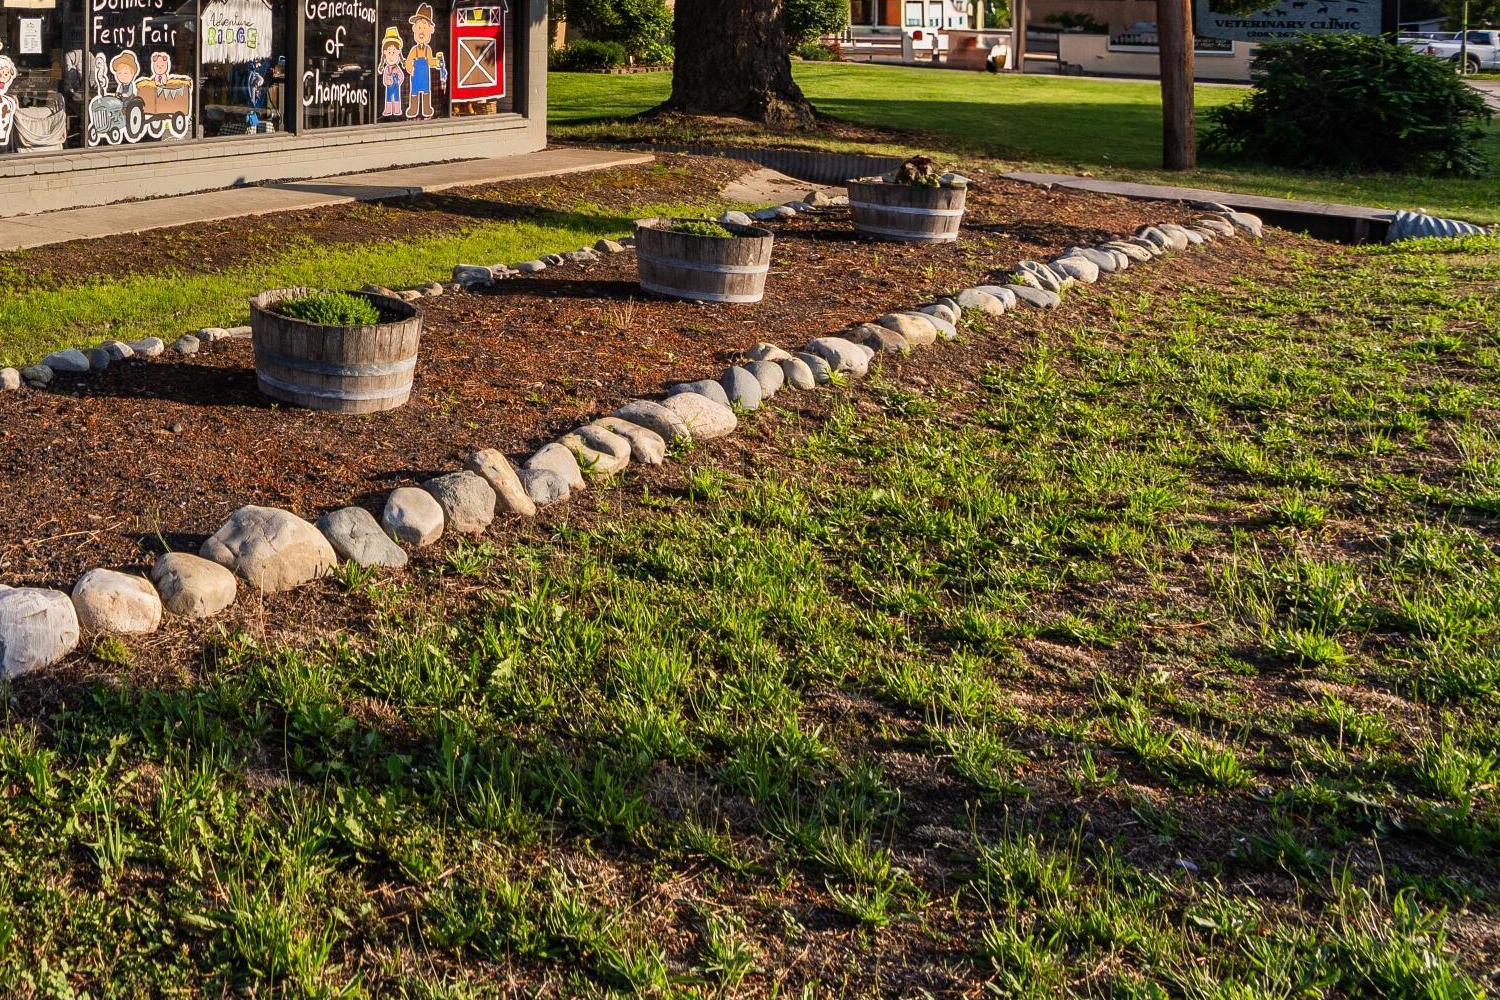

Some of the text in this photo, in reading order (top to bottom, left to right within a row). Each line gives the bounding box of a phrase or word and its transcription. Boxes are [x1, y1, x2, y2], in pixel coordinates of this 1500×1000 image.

[93, 15, 177, 48] Ferry Fair
[208, 10, 253, 27] Adventure
[1215, 19, 1361, 30] VETERINARY CLINIC
[325, 25, 347, 59] of
[302, 68, 368, 107] Champions
